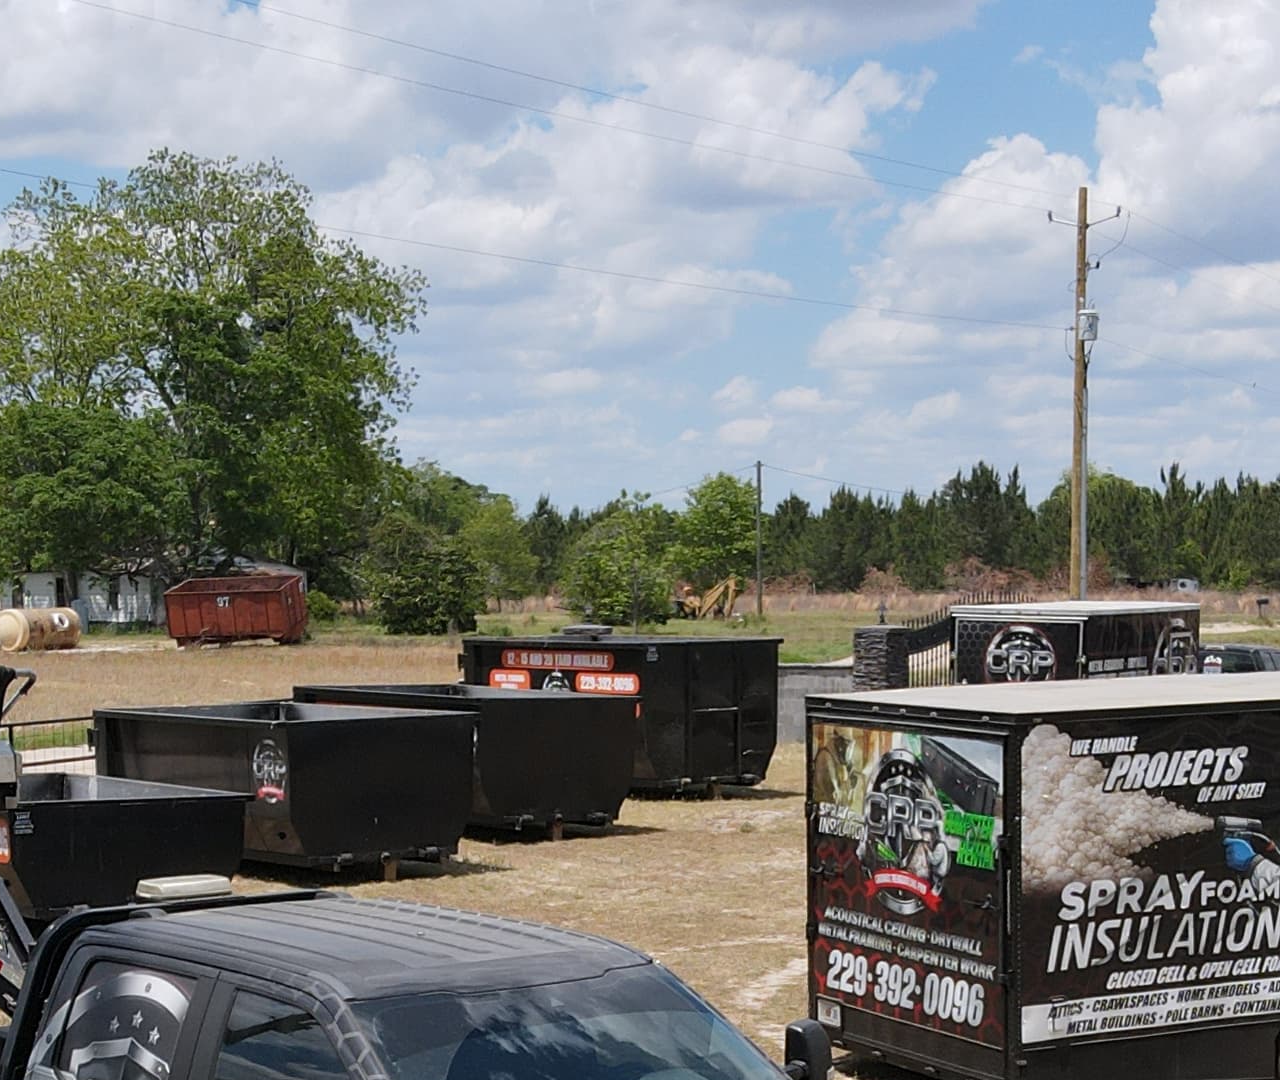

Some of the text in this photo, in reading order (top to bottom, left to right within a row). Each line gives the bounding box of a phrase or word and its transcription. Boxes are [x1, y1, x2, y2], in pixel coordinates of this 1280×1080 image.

[987, 649, 1056, 675] CRP
[1071, 736, 1138, 756] WE HANDLE
[1104, 746, 1249, 791] PROJECTS
[1197, 786, 1214, 803] OF
[1212, 784, 1237, 802] ANY
[865, 791, 938, 839] CRP
[1057, 870, 1280, 921] SPRAY FOAM
[824, 906, 982, 956] ACOUSTICAL CEILING DRYWALL
[897, 942, 958, 972] CARPENTER
[960, 957, 996, 981] WORK
[1106, 968, 1157, 990] CLOSED
[1157, 965, 1187, 984] CELL
[1199, 960, 1232, 979] OPEN
[1232, 956, 1262, 973] CELL
[1092, 992, 1169, 1012] CRAWLSPACES
[1177, 988, 1208, 1003] HOME
[1207, 982, 1261, 999] REMODELS
[1066, 1018, 1098, 1034] METAL
[1100, 1012, 1157, 1030] BUILDINGS
[1165, 1007, 1190, 1023] POLE
[1190, 1004, 1225, 1019] BARNS
